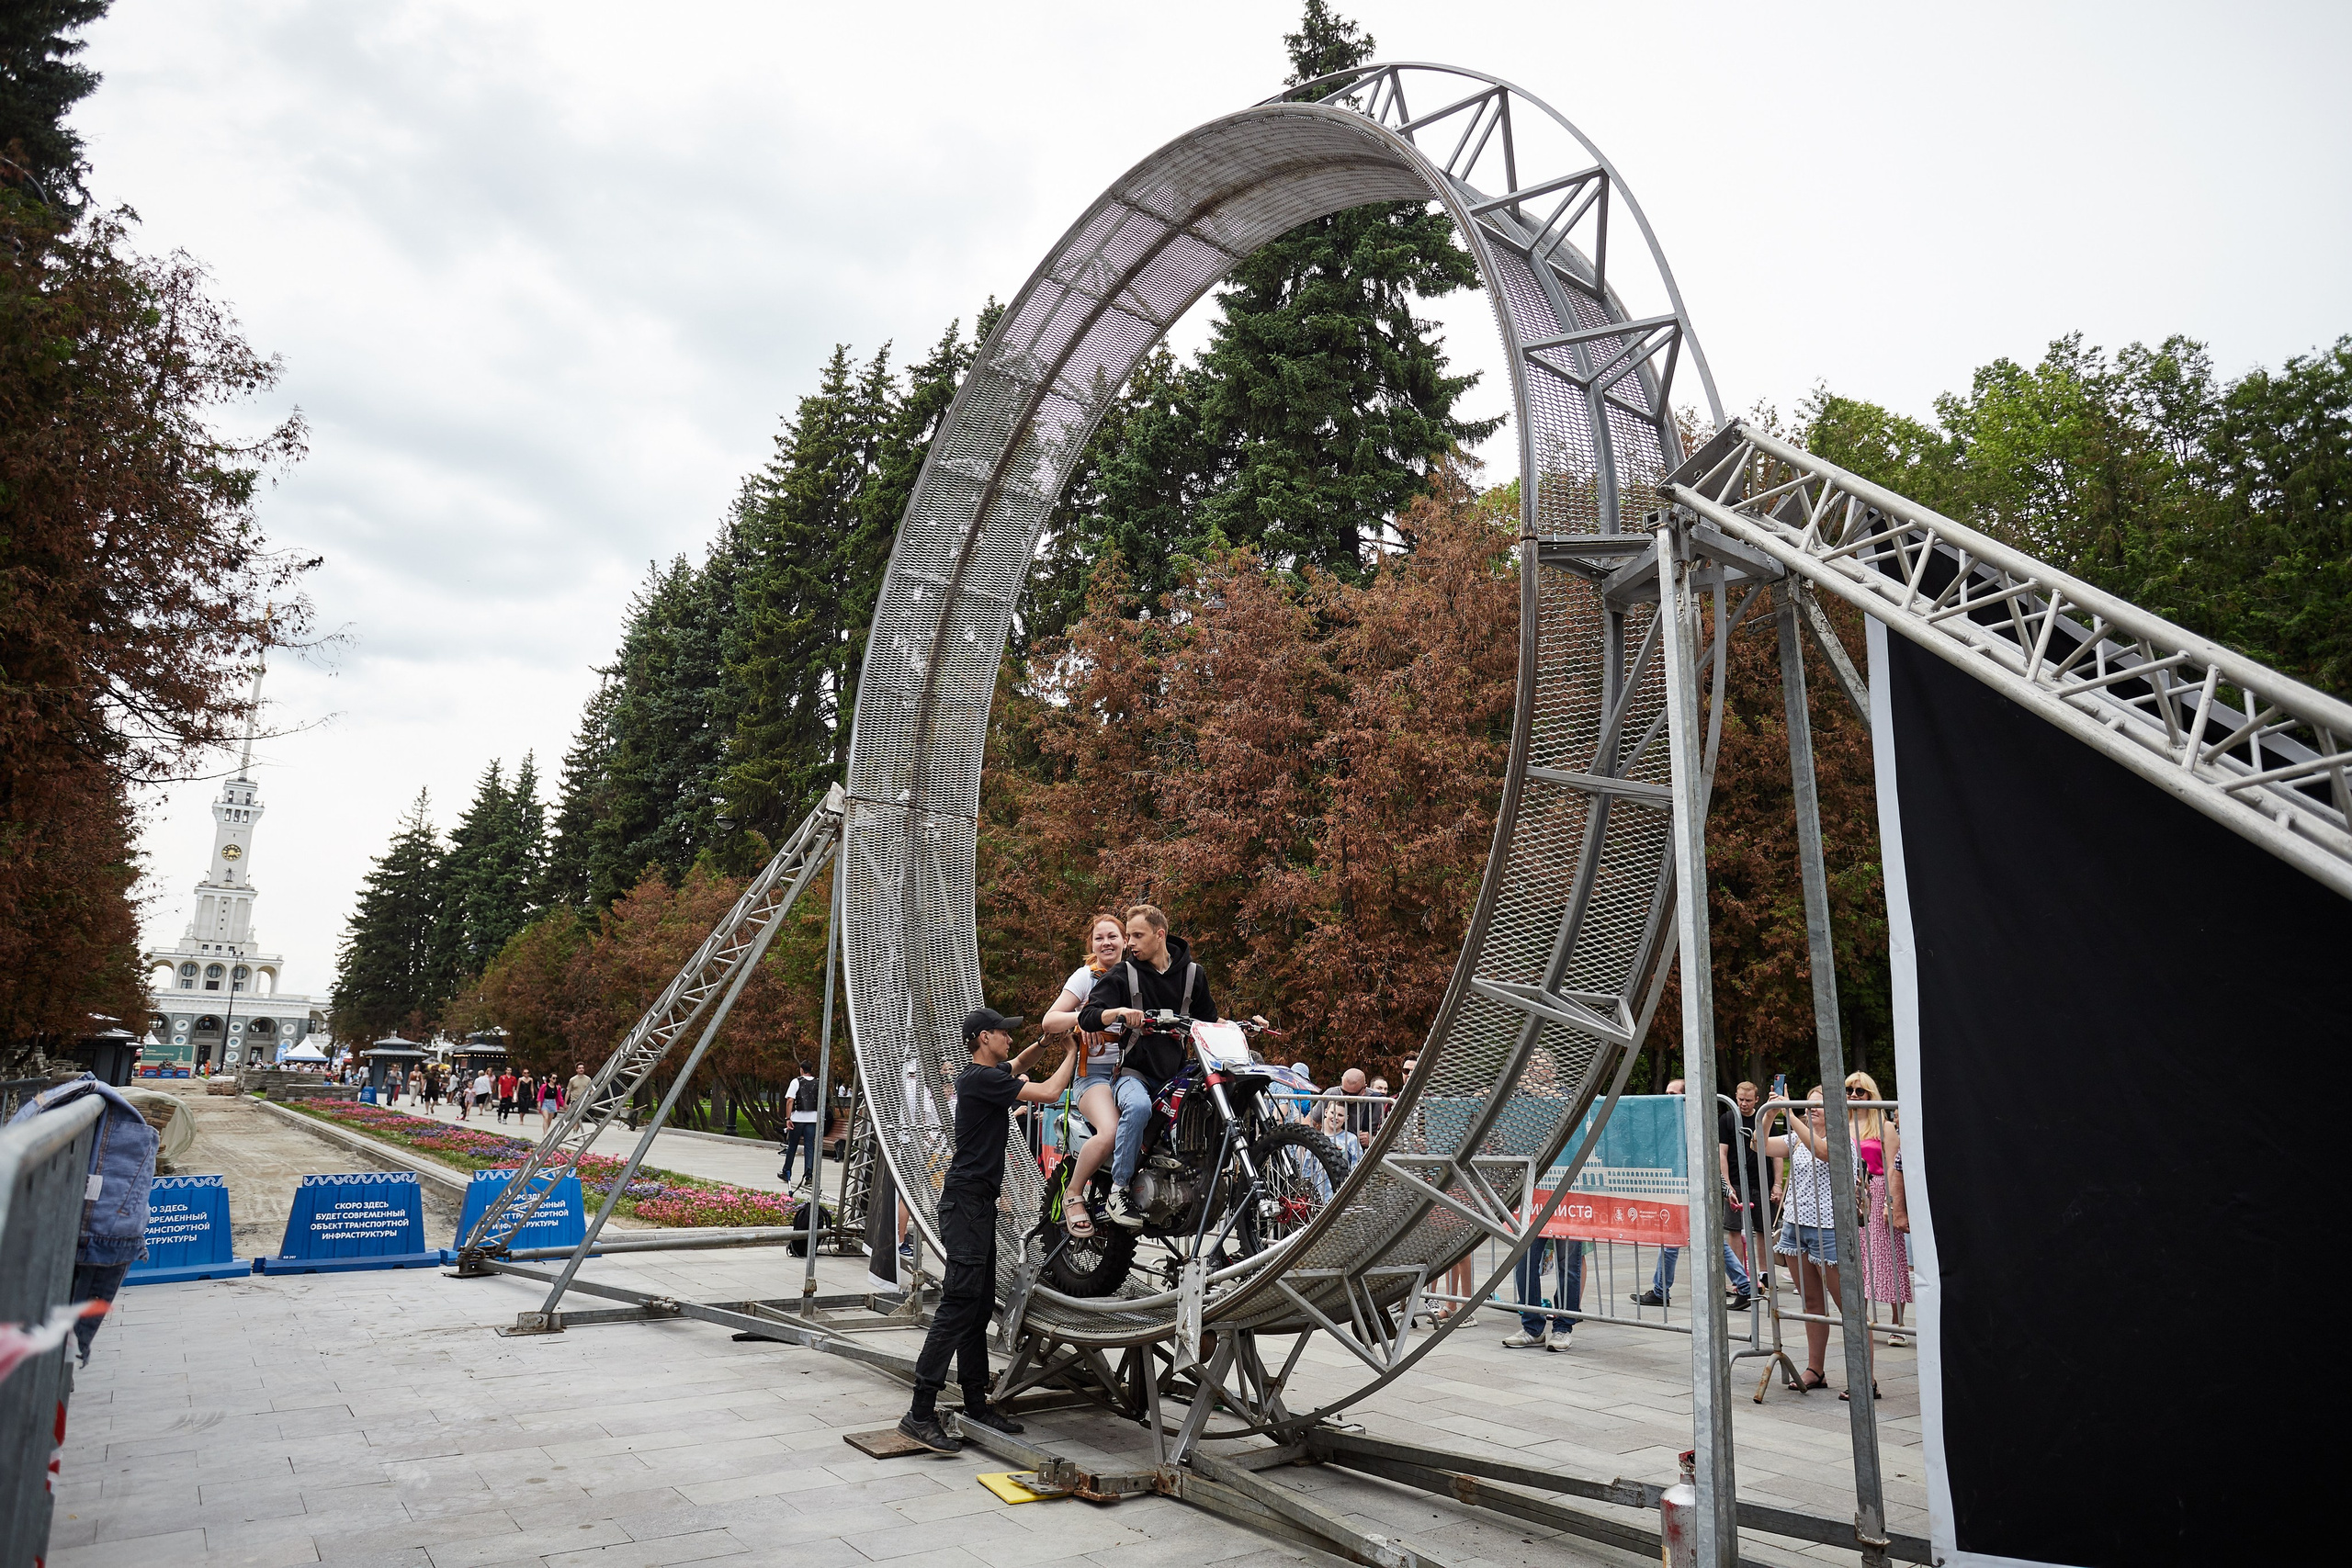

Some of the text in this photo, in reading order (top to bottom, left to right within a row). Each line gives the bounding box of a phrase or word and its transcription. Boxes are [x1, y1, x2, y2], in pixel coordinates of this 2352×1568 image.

[1160, 1105, 1176, 1118] BSE
[159, 1204, 188, 1213] ЗДЕСЬ
[148, 1212, 208, 1224] ВРЕМЕННЫЙ
[343, 1209, 405, 1219] СОВРЕМЕННЫЙ
[143, 1222, 210, 1234] РАНСПОРТНОЙ
[345, 1219, 410, 1229] ТРАНСПОРТНОЙ
[145, 1234, 198, 1245] СТРУКТУРЫ
[322, 1230, 397, 1239] ИНФРАСТРУКТУРЫ
